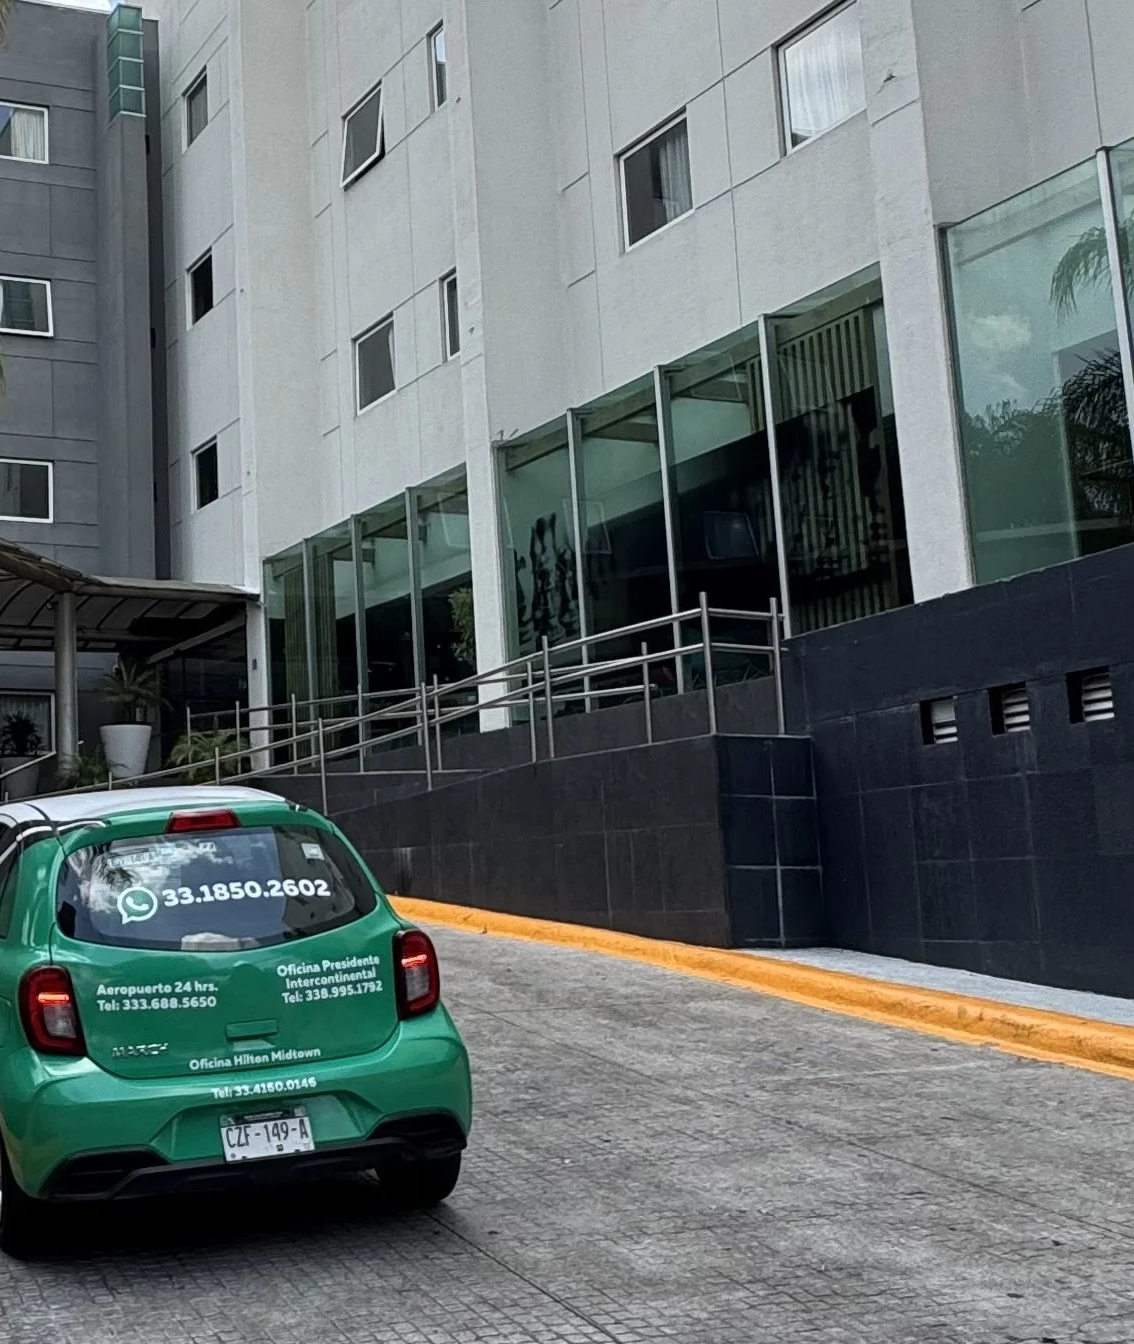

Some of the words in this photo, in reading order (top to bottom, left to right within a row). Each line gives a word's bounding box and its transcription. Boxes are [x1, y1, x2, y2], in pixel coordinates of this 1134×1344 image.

[162, 879, 331, 907] 33.1850.2602
[277, 962, 320, 977] Oficina
[321, 955, 380, 972] Presidente
[96, 983, 172, 997] Aeropuerto
[174, 981, 192, 993] 24
[194, 980, 219, 992] hrs.
[285, 966, 377, 990] Intercontinental
[96, 999, 120, 1011] Tel:
[122, 996, 217, 1011] 333.688.5650
[281, 991, 304, 1004] Tel:
[189, 1057, 232, 1070] Oficina
[233, 1054, 269, 1066] Hilton
[271, 1048, 321, 1062] Midtown
[225, 1118, 309, 1149] CZF-149-A
